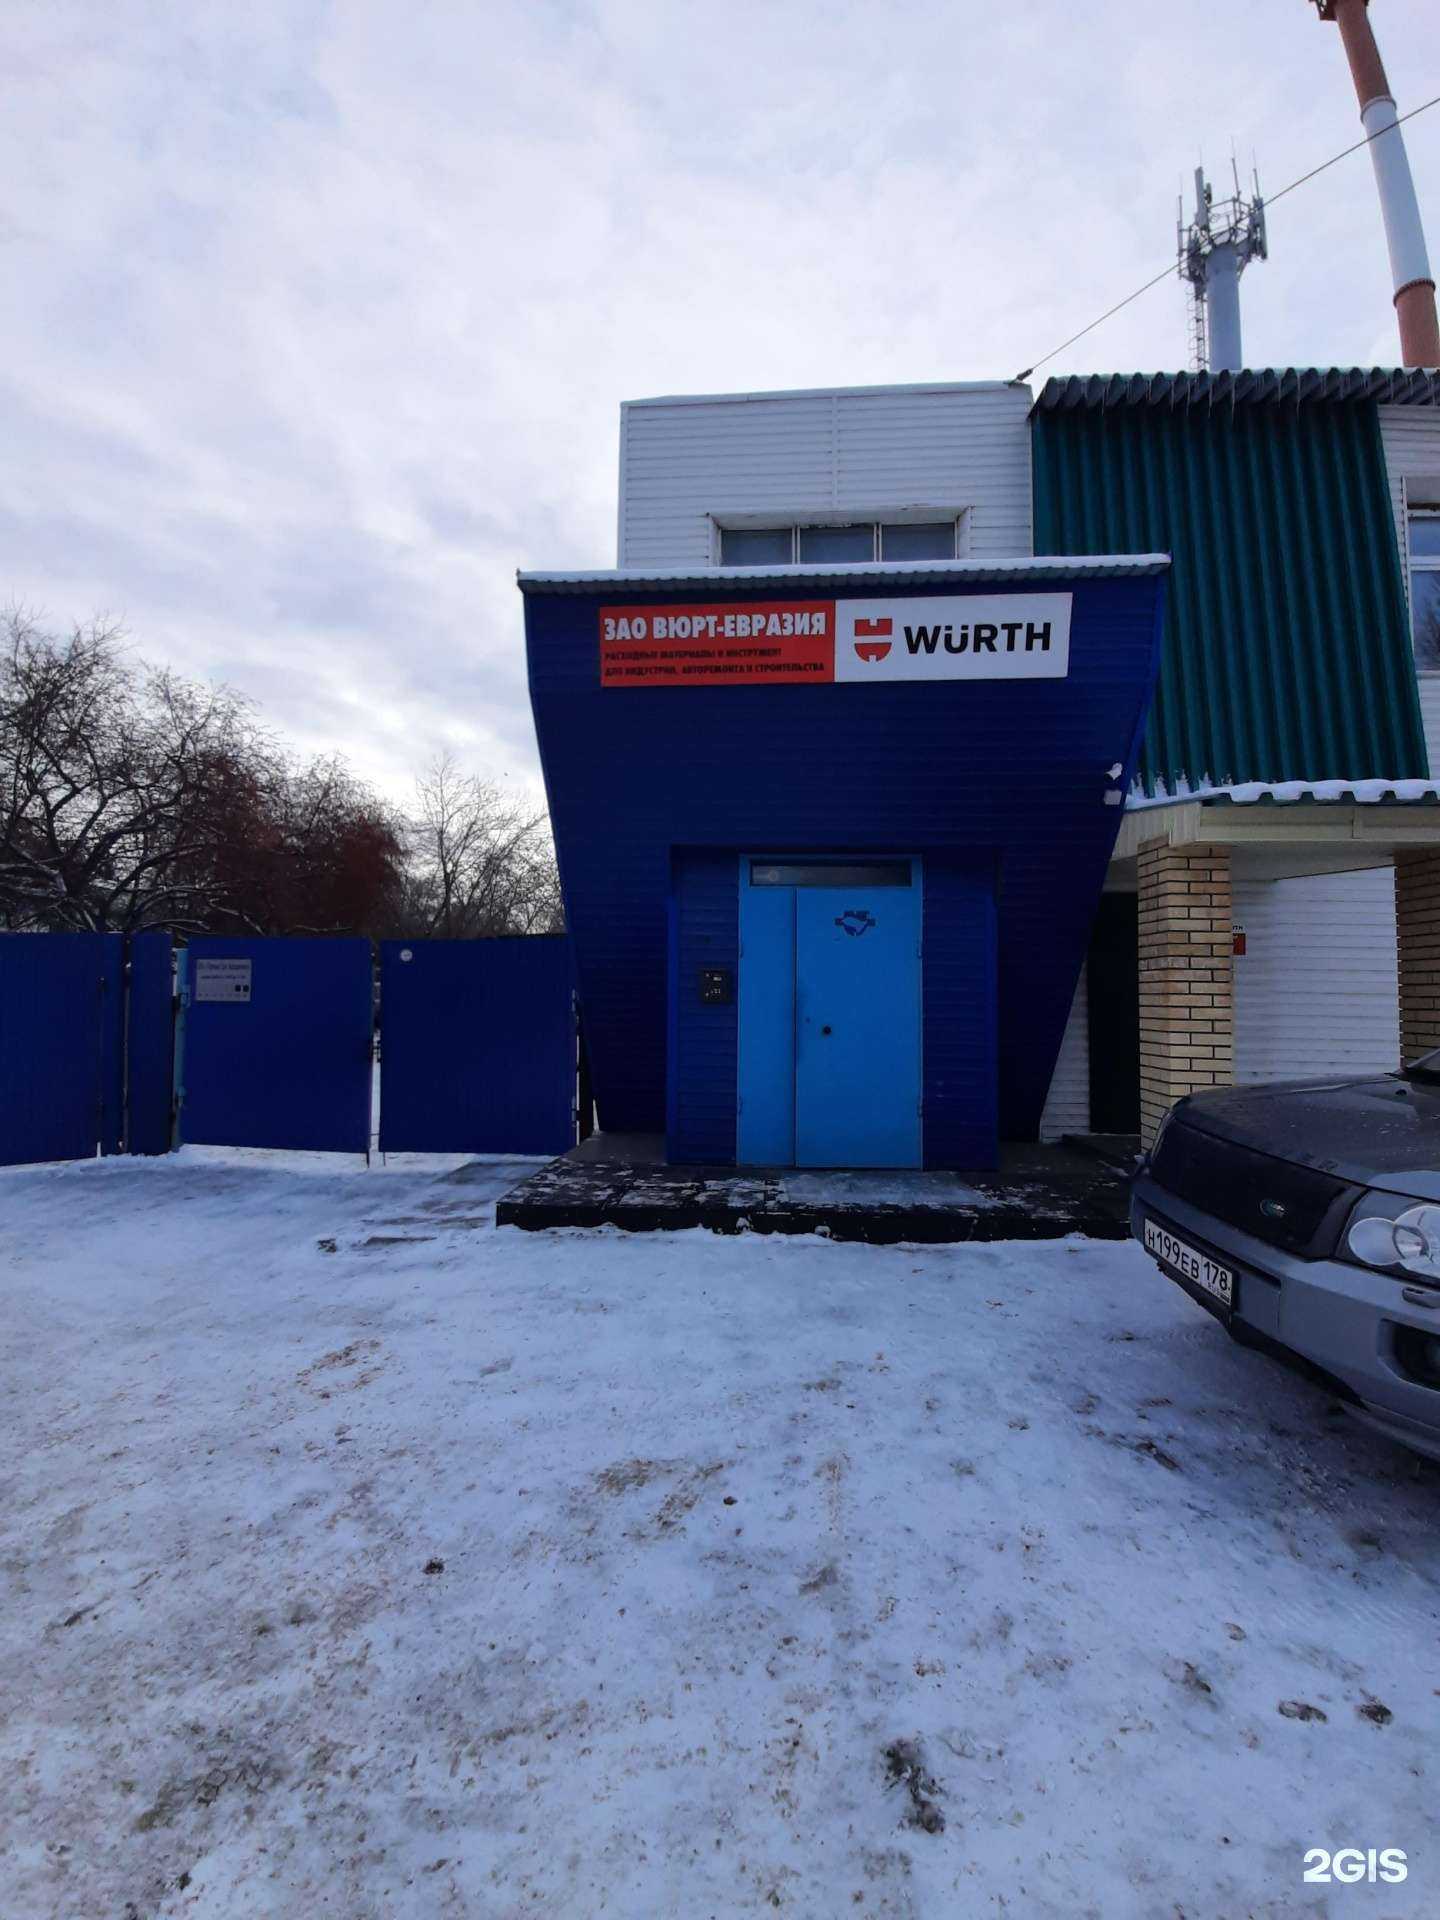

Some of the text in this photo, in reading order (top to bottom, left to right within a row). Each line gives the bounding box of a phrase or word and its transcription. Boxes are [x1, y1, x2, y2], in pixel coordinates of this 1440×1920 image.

[604, 612, 826, 641] ЗАО ВЮРТ-ЕВРАЗИЯ
[1203, 1261, 1228, 1291] 178
